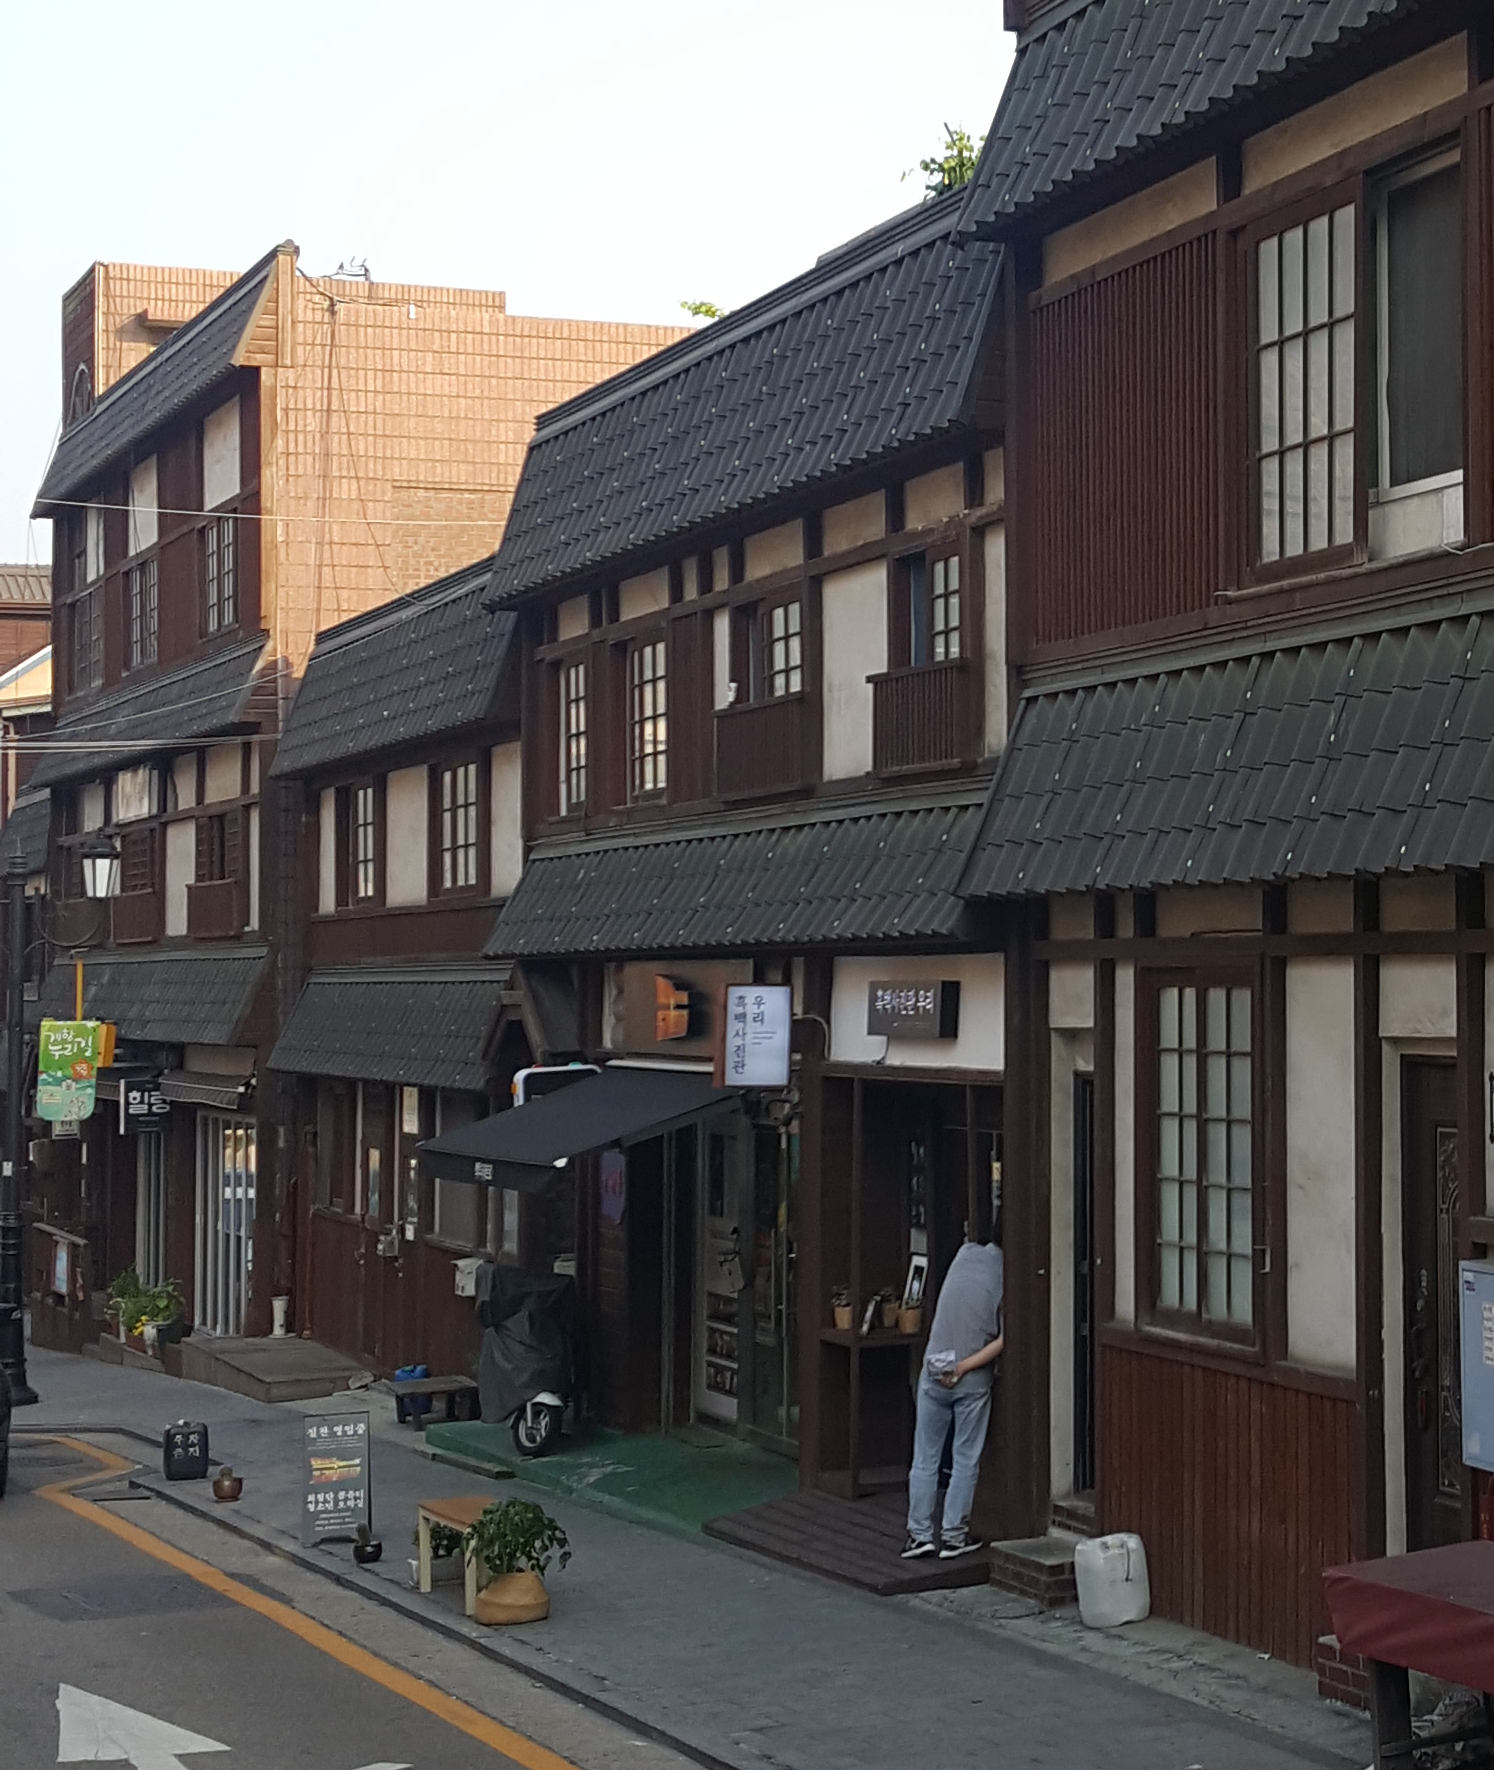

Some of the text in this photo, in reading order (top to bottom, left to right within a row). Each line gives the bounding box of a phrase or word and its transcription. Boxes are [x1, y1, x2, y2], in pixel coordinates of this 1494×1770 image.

[751, 995, 767, 1027] 우리
[44, 1028, 76, 1043] 개항
[48, 1035, 93, 1061] 누리길
[732, 994, 748, 1075] 흑백사진관
